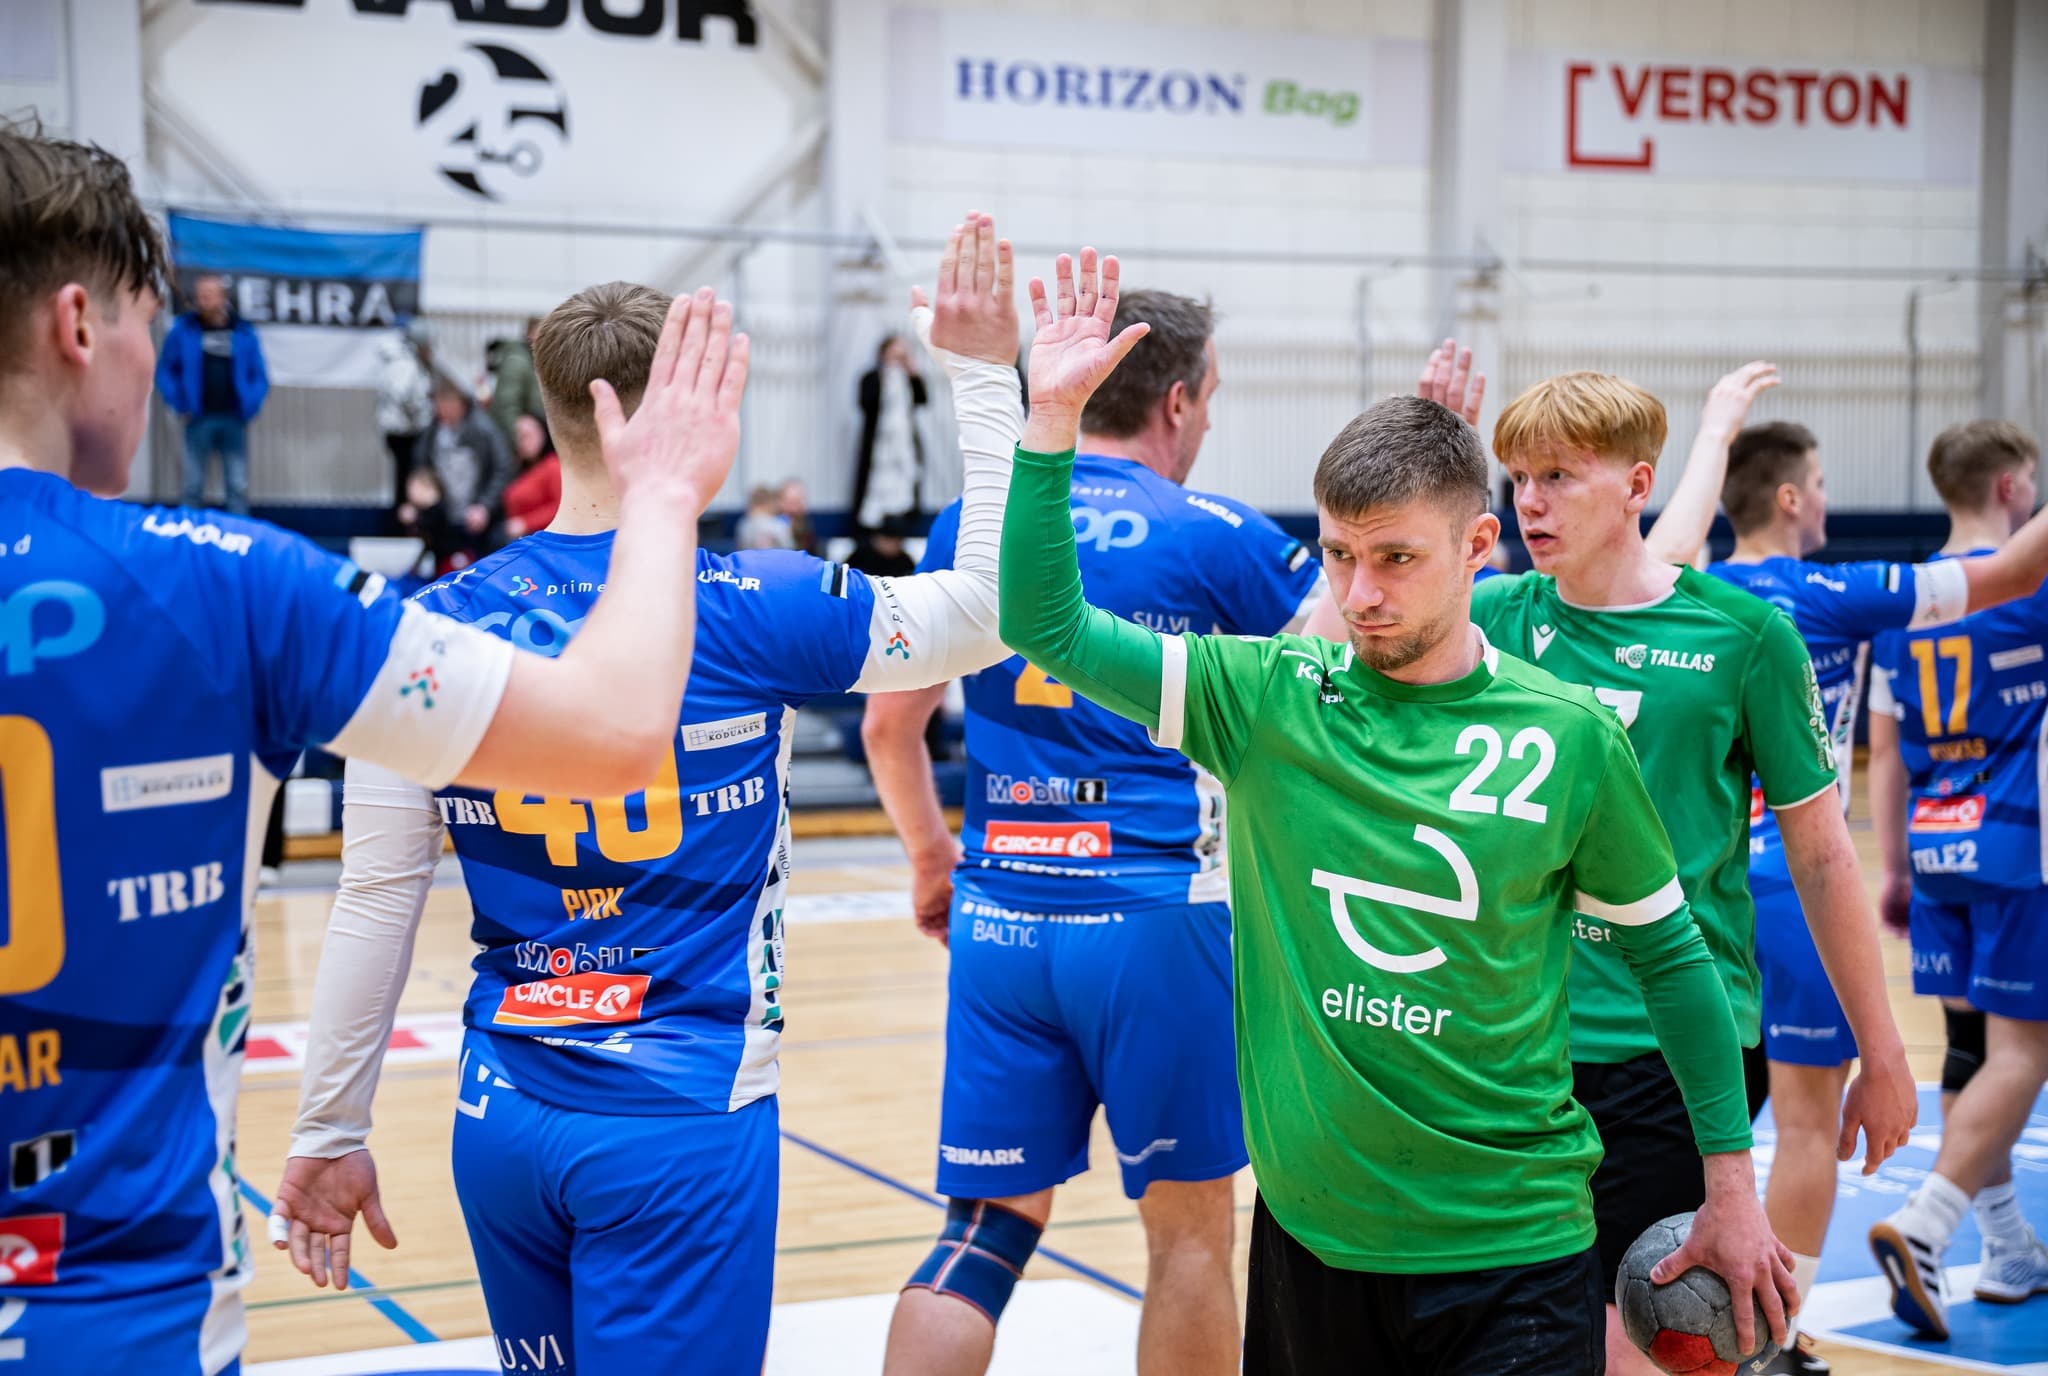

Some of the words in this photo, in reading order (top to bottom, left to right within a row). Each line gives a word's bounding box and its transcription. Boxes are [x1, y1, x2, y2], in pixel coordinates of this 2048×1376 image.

[956, 58, 1247, 114] HORIZON
[1611, 64, 1909, 130] VERSTON
[220, 274, 396, 326] EHRA
[1650, 649, 1715, 673] TALLAS
[1909, 635, 1973, 737] 17
[986, 774, 1070, 805] Mobil
[1449, 724, 1556, 824] 22
[436, 797, 497, 825] TRB
[691, 776, 765, 816] TRB
[991, 834, 1065, 853] CIRCLE
[107, 861, 225, 923] TRB
[562, 886, 625, 921] PIRK
[972, 920, 1038, 948] BALTIC
[515, 941, 623, 977] Mobil
[514, 980, 594, 1010] CIRCLE
[1322, 983, 1452, 1036] elister
